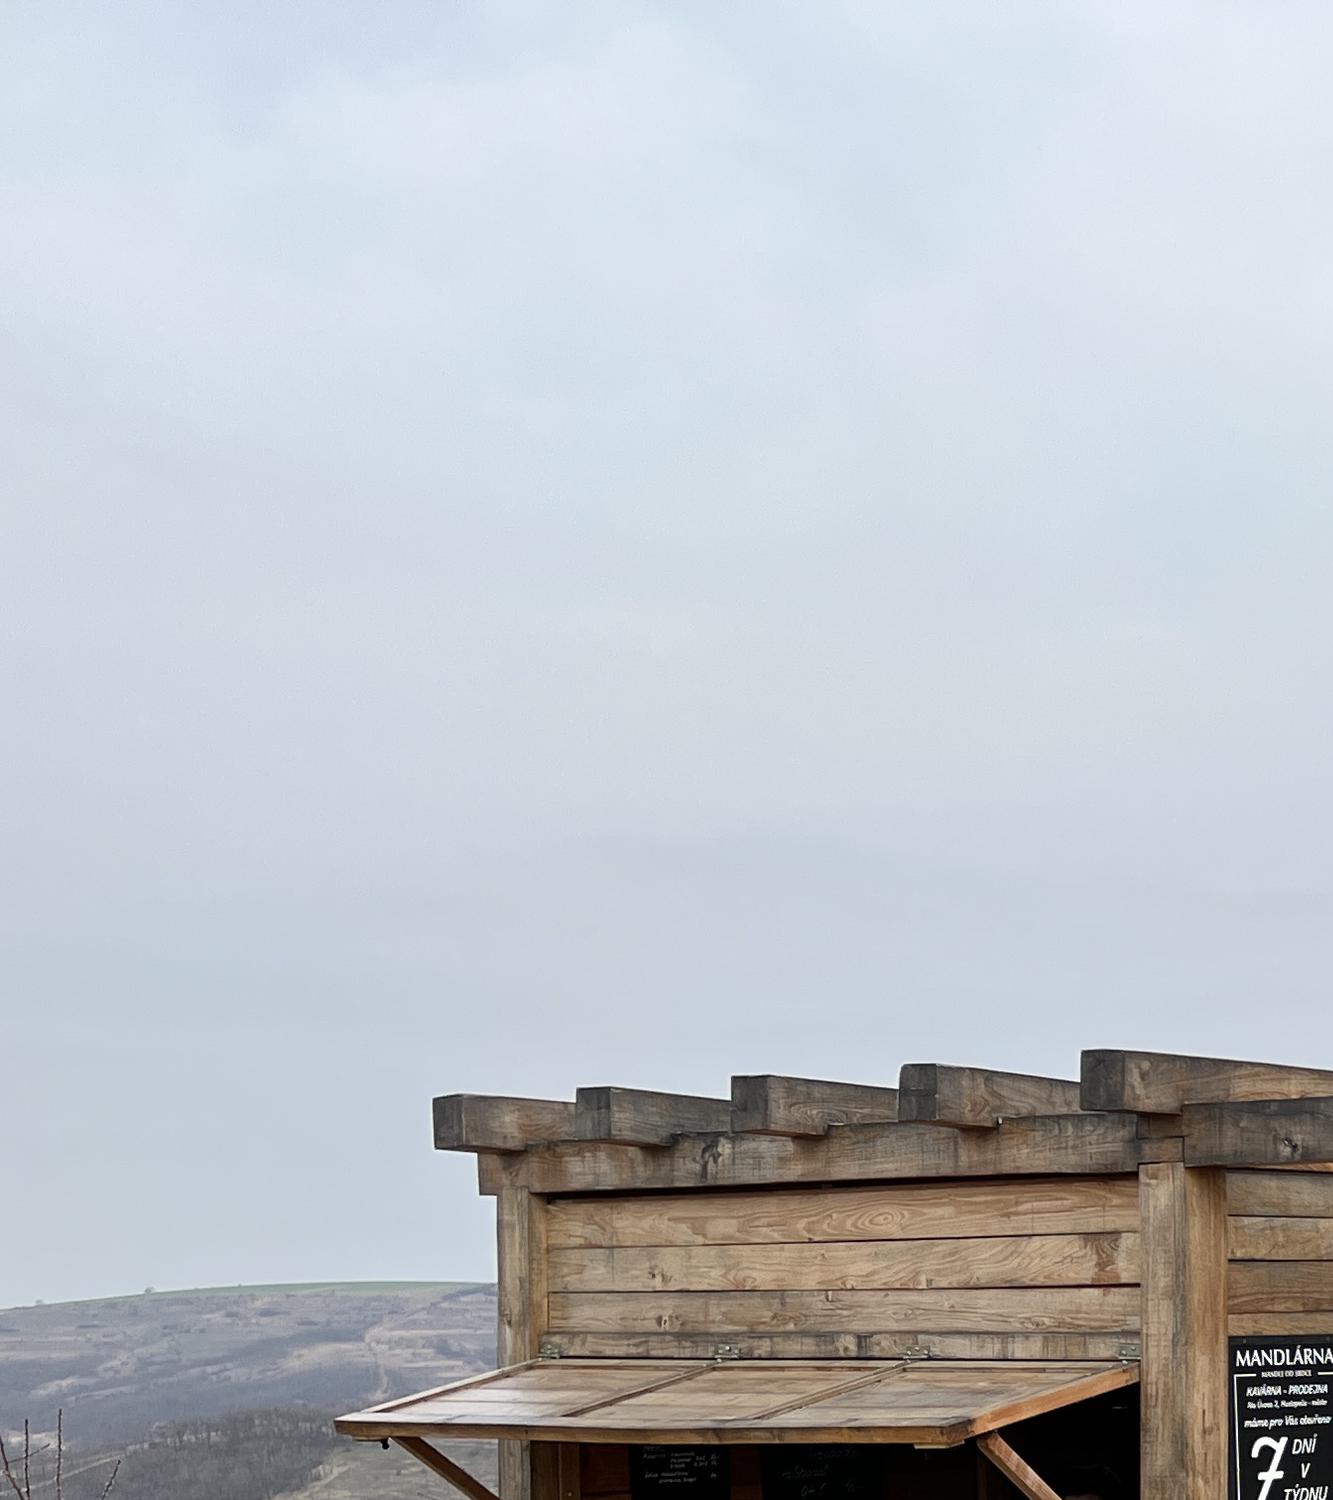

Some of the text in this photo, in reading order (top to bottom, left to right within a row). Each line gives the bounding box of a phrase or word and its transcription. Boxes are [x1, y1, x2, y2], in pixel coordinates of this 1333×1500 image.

[1246, 1384, 1282, 1397] KAVÁRNA
[1288, 1383, 1329, 1395] PRODEJNA
[1269, 1418, 1284, 1430] pro
[1292, 1433, 1318, 1455] DNÍ
[1301, 1462, 1311, 1479] V
